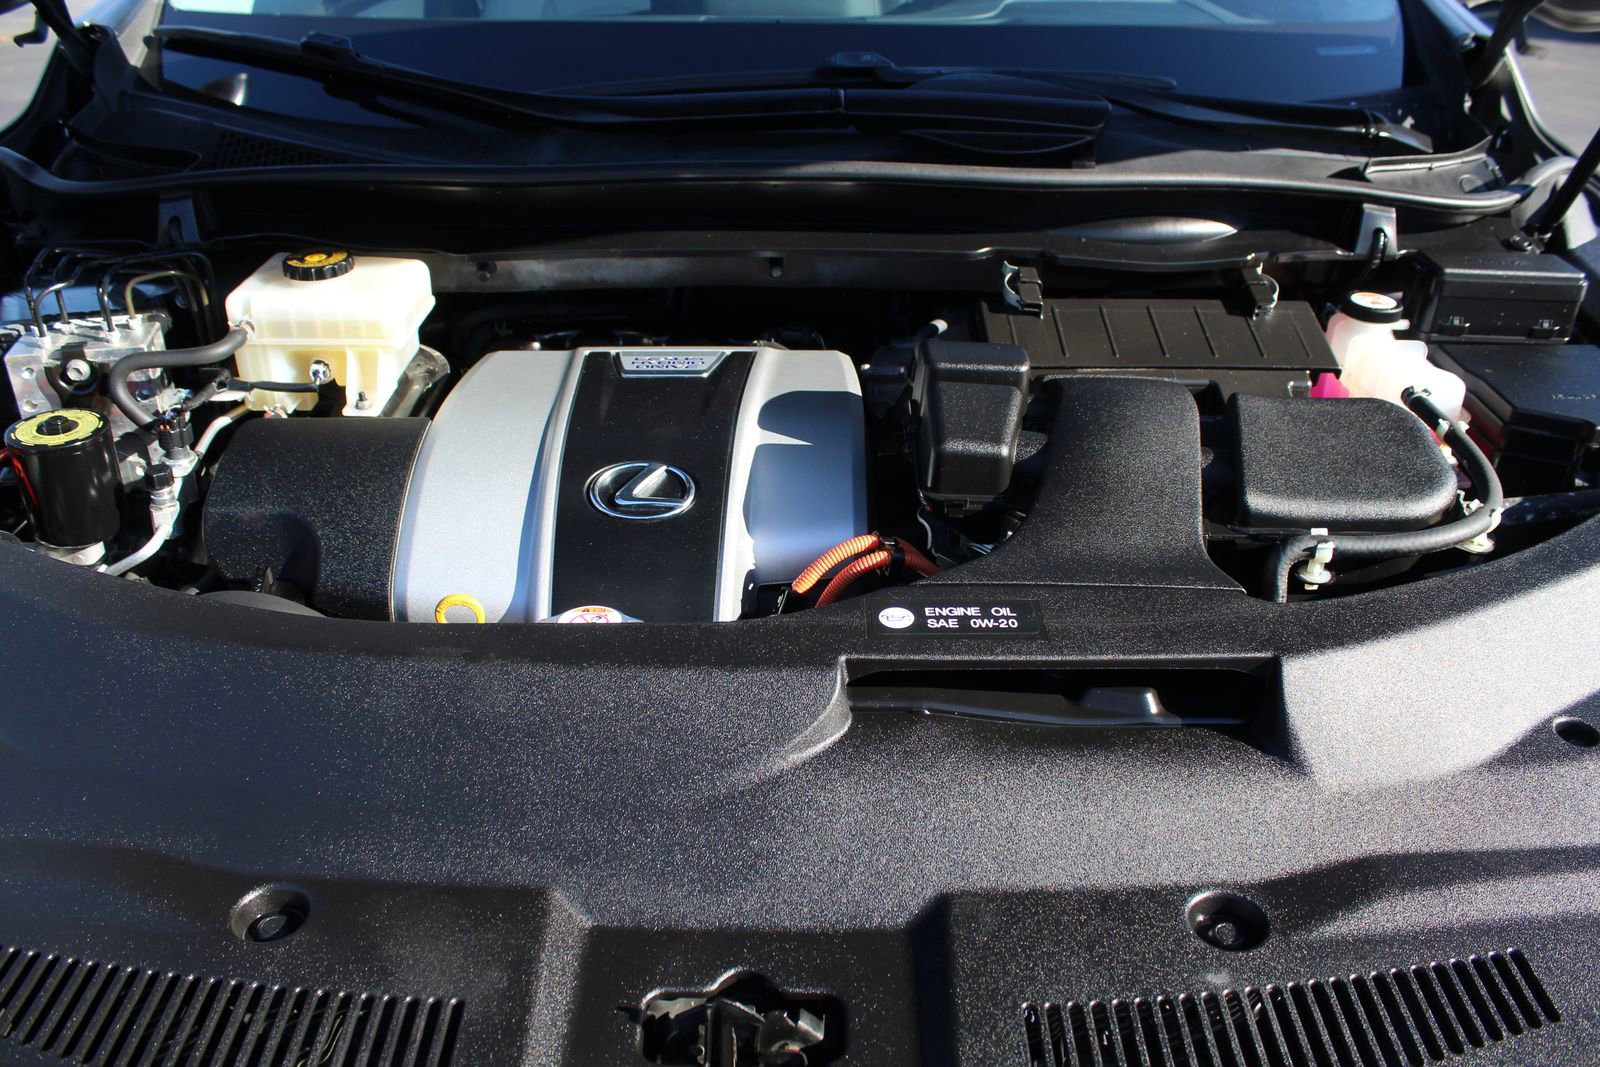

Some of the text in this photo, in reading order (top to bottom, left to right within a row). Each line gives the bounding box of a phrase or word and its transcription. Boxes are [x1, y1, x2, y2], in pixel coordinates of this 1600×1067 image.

[924, 607, 1017, 617] ENGINE OIL
[927, 618, 1019, 628] SAE 0W-20
